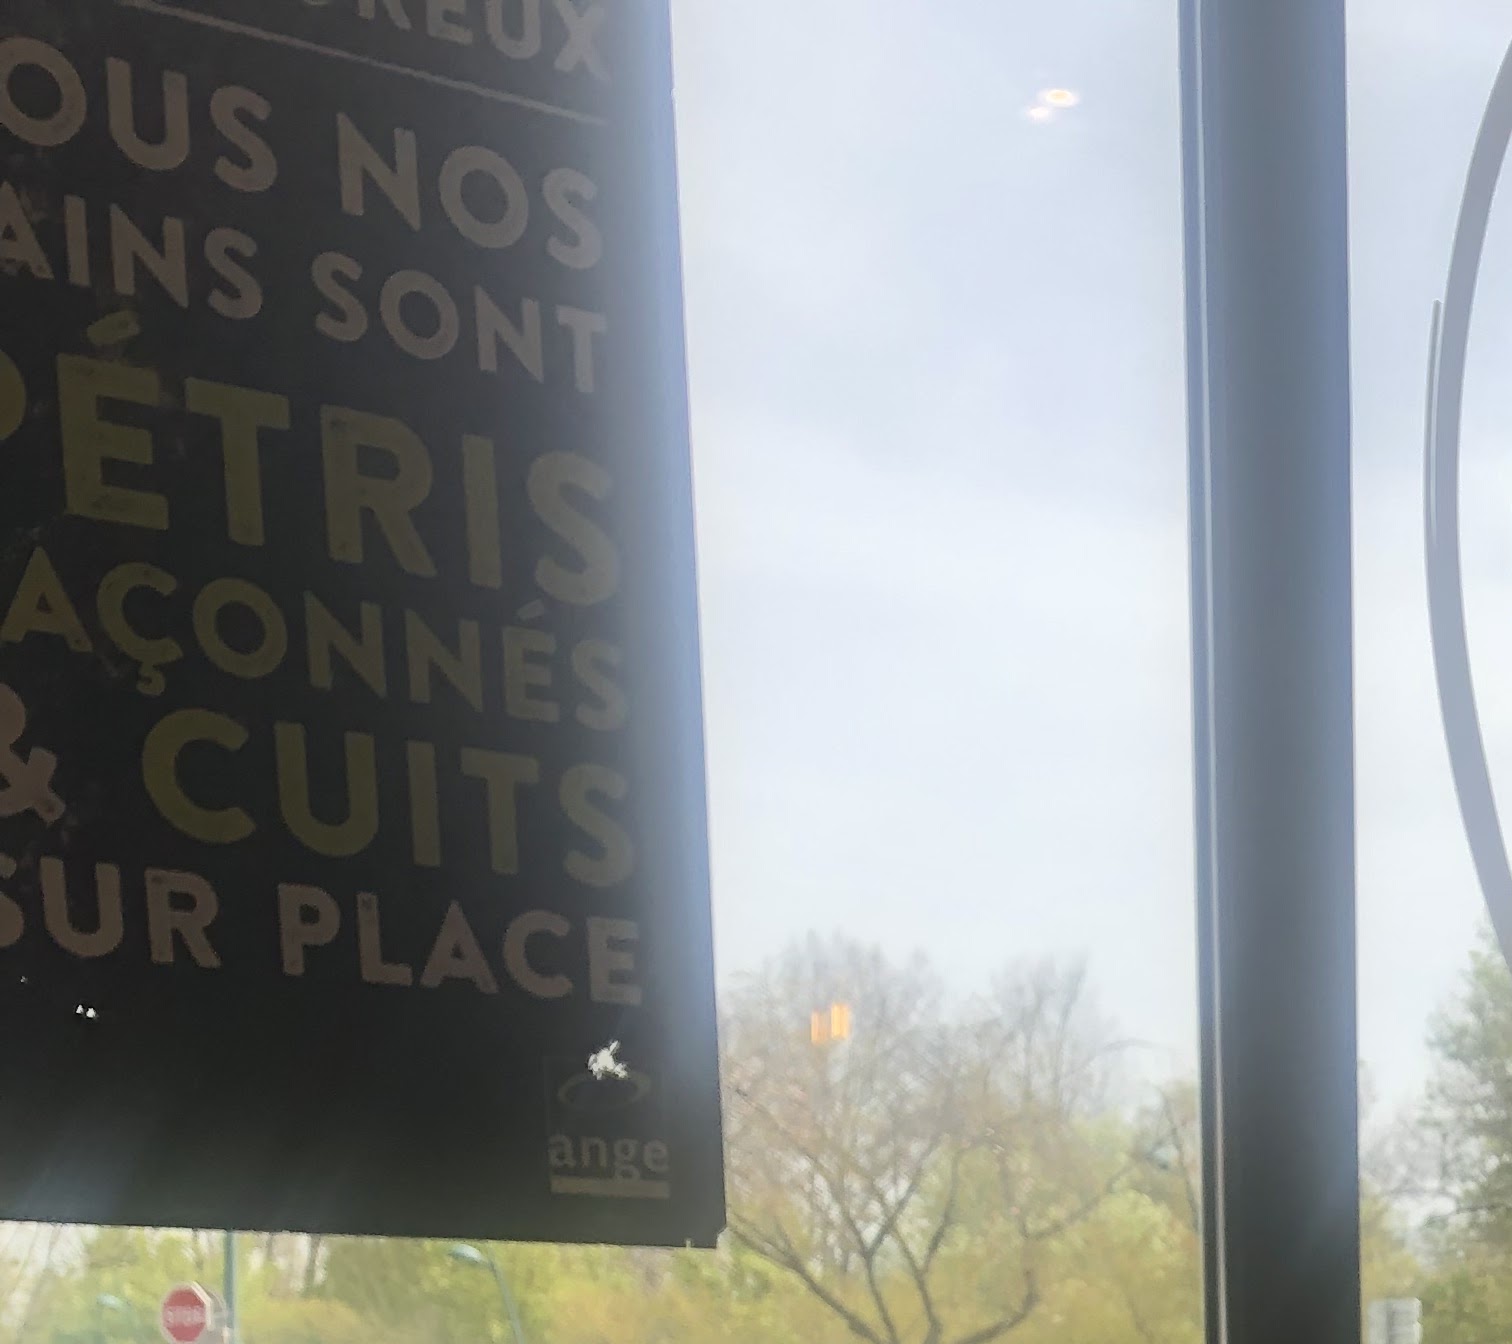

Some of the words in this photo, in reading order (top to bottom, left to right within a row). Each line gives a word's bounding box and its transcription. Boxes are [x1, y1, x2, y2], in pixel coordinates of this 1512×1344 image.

[336, 112, 600, 270] NOS
[311, 252, 608, 393] SONT
[2, 545, 627, 732] AÇONNÉS
[142, 707, 637, 888] CUITS
[277, 882, 643, 1005] PLACE
[548, 1134, 670, 1183] ange
